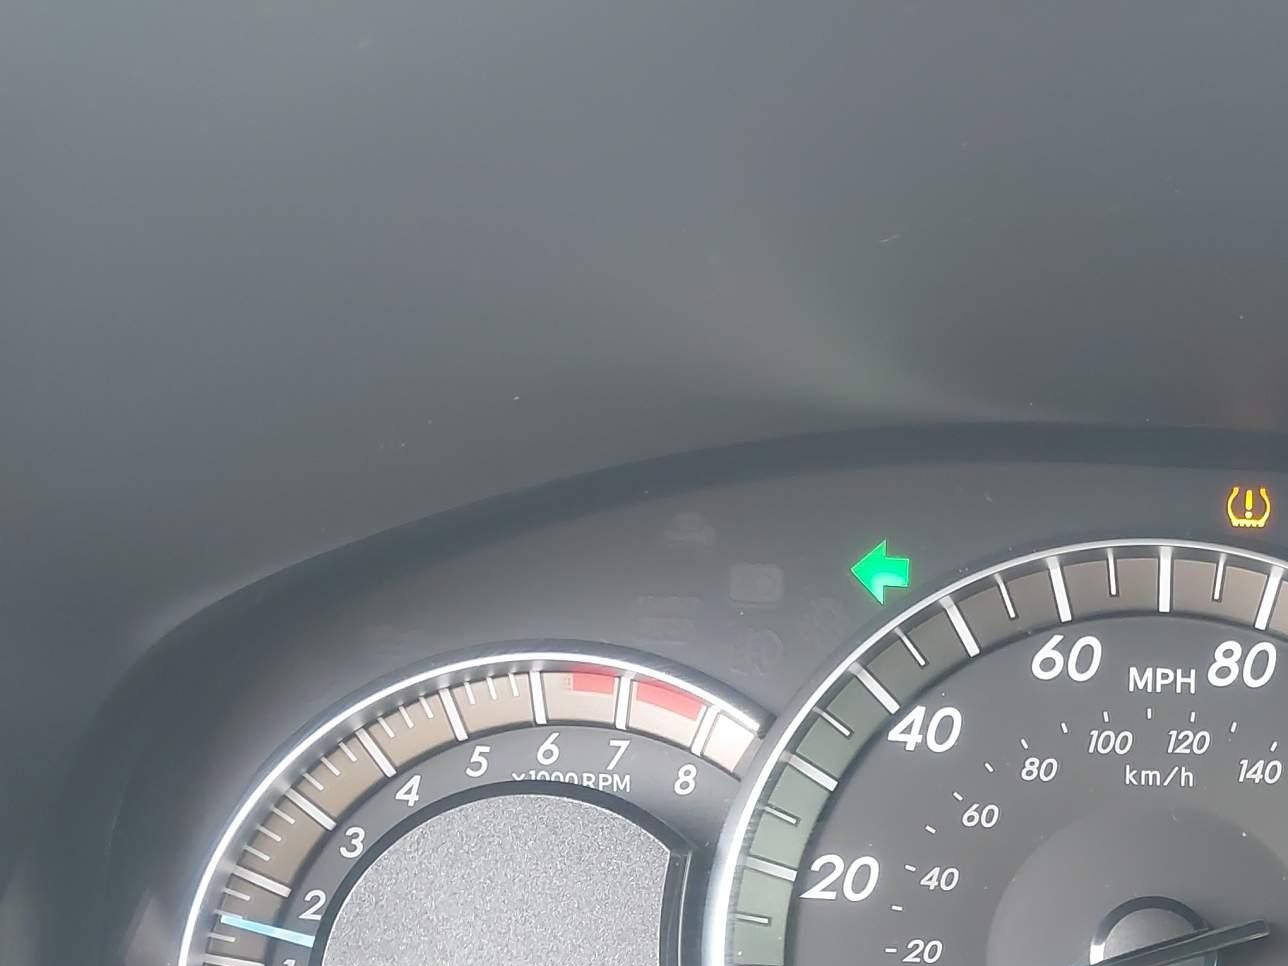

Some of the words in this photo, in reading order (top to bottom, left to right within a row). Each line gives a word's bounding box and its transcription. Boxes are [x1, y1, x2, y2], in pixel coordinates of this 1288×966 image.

[1032, 635, 1101, 681] 60
[1208, 641, 1276, 687] 80
[1129, 667, 1195, 693] MPH
[887, 706, 961, 752] 40
[1089, 730, 1132, 754] 100
[1168, 731, 1210, 754] 120
[466, 746, 488, 777] 5
[537, 733, 559, 764] 6
[607, 740, 630, 770] 7
[584, 773, 630, 792] RPM
[675, 765, 696, 794] 8
[1022, 758, 1057, 781] 80
[1125, 764, 1195, 788] km/h
[1239, 760, 1281, 783] 140
[397, 775, 419, 806] 4
[963, 804, 998, 827] 60
[340, 827, 364, 858] 3
[801, 855, 879, 901] 20
[920, 867, 958, 890] 40
[299, 890, 326, 920] 2
[903, 940, 942, 963] 20
